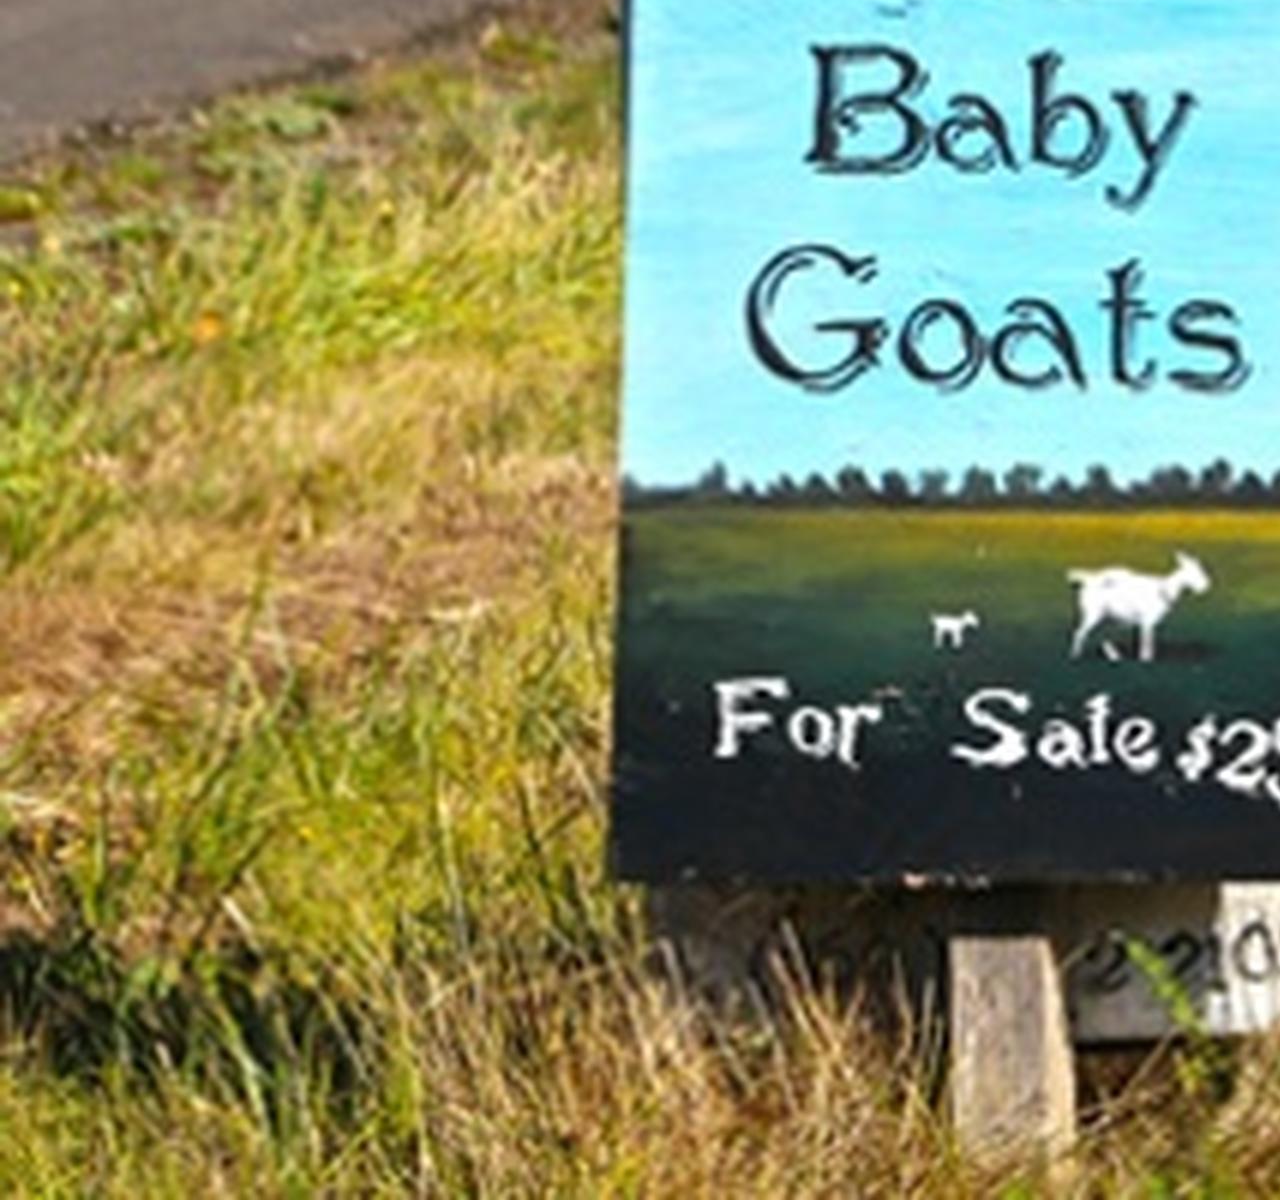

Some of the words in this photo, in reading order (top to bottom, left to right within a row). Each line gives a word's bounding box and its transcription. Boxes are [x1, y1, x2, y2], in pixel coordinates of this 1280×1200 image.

[803, 42, 1199, 209] Baby
[744, 243, 1253, 394] Goats
[713, 676, 884, 768] For
[951, 687, 1161, 771] Sale
